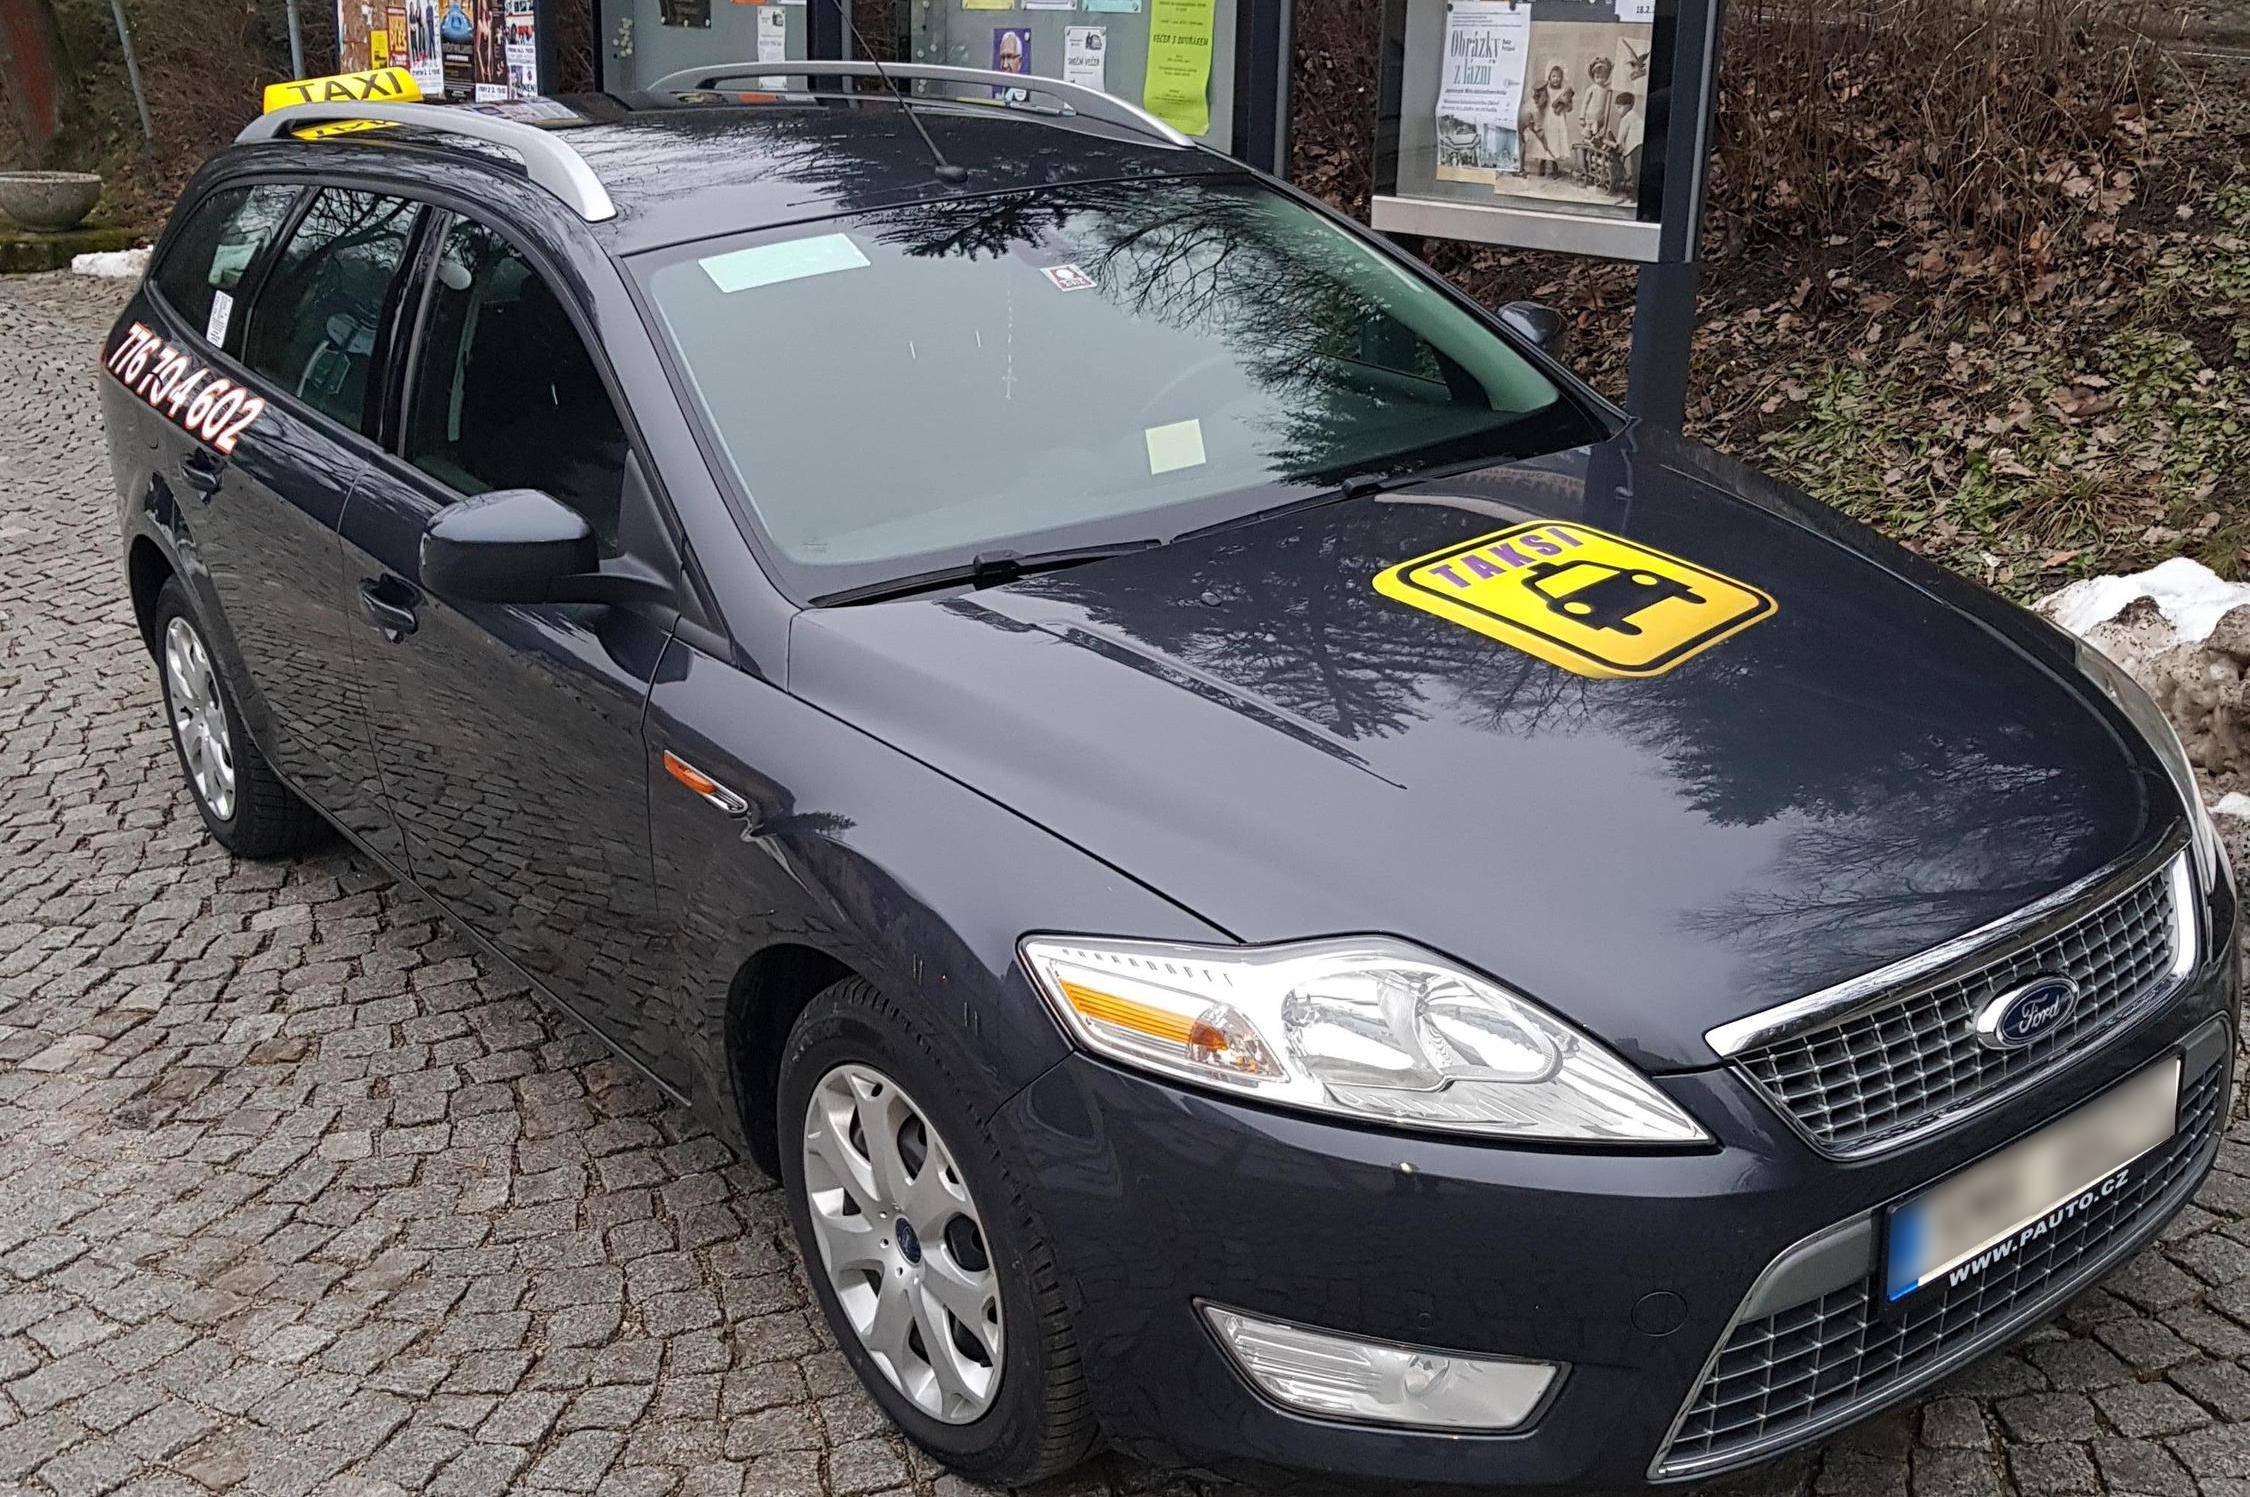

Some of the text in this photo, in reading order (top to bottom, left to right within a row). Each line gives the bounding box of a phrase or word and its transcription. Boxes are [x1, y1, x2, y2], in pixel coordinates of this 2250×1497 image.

[1451, 30, 1501, 62] Obrázky
[286, 71, 404, 102] TAXI
[106, 321, 163, 385] 776
[184, 377, 267, 456] 602
[1429, 527, 1584, 588] TAKSI
[2018, 993, 2060, 1034] Ford
[1948, 1168, 2130, 1288] WWW.PAUTO.CZ
